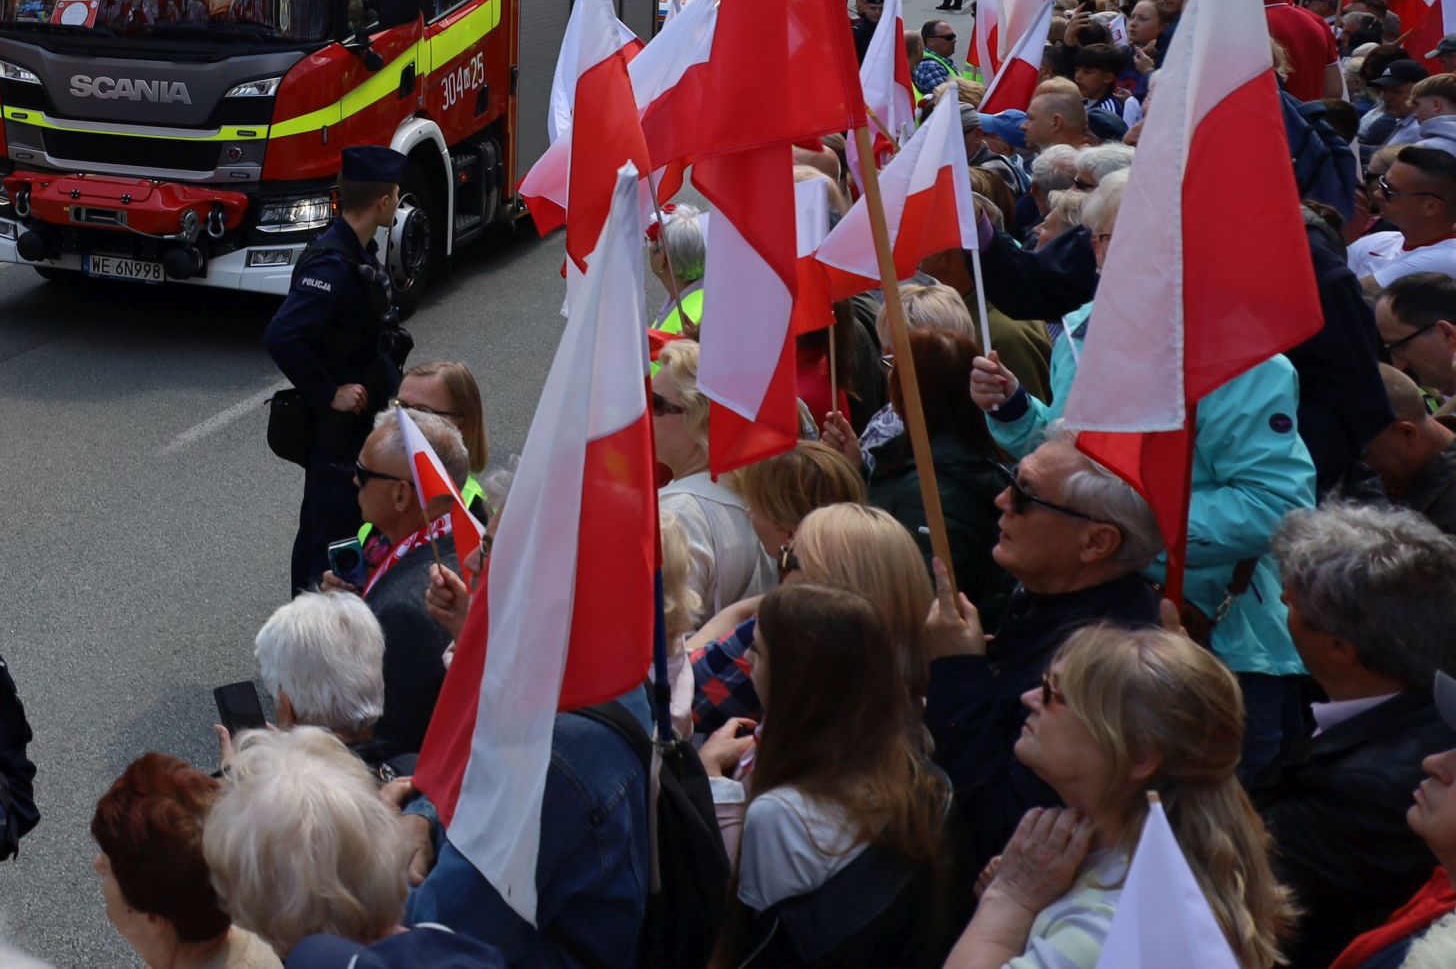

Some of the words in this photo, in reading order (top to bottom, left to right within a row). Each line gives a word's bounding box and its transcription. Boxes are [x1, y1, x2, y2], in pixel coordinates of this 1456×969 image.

[69, 74, 193, 105] SCANIA
[92, 256, 111, 274] WE
[115, 260, 161, 280] 6N998
[301, 277, 332, 292] POLICJA
